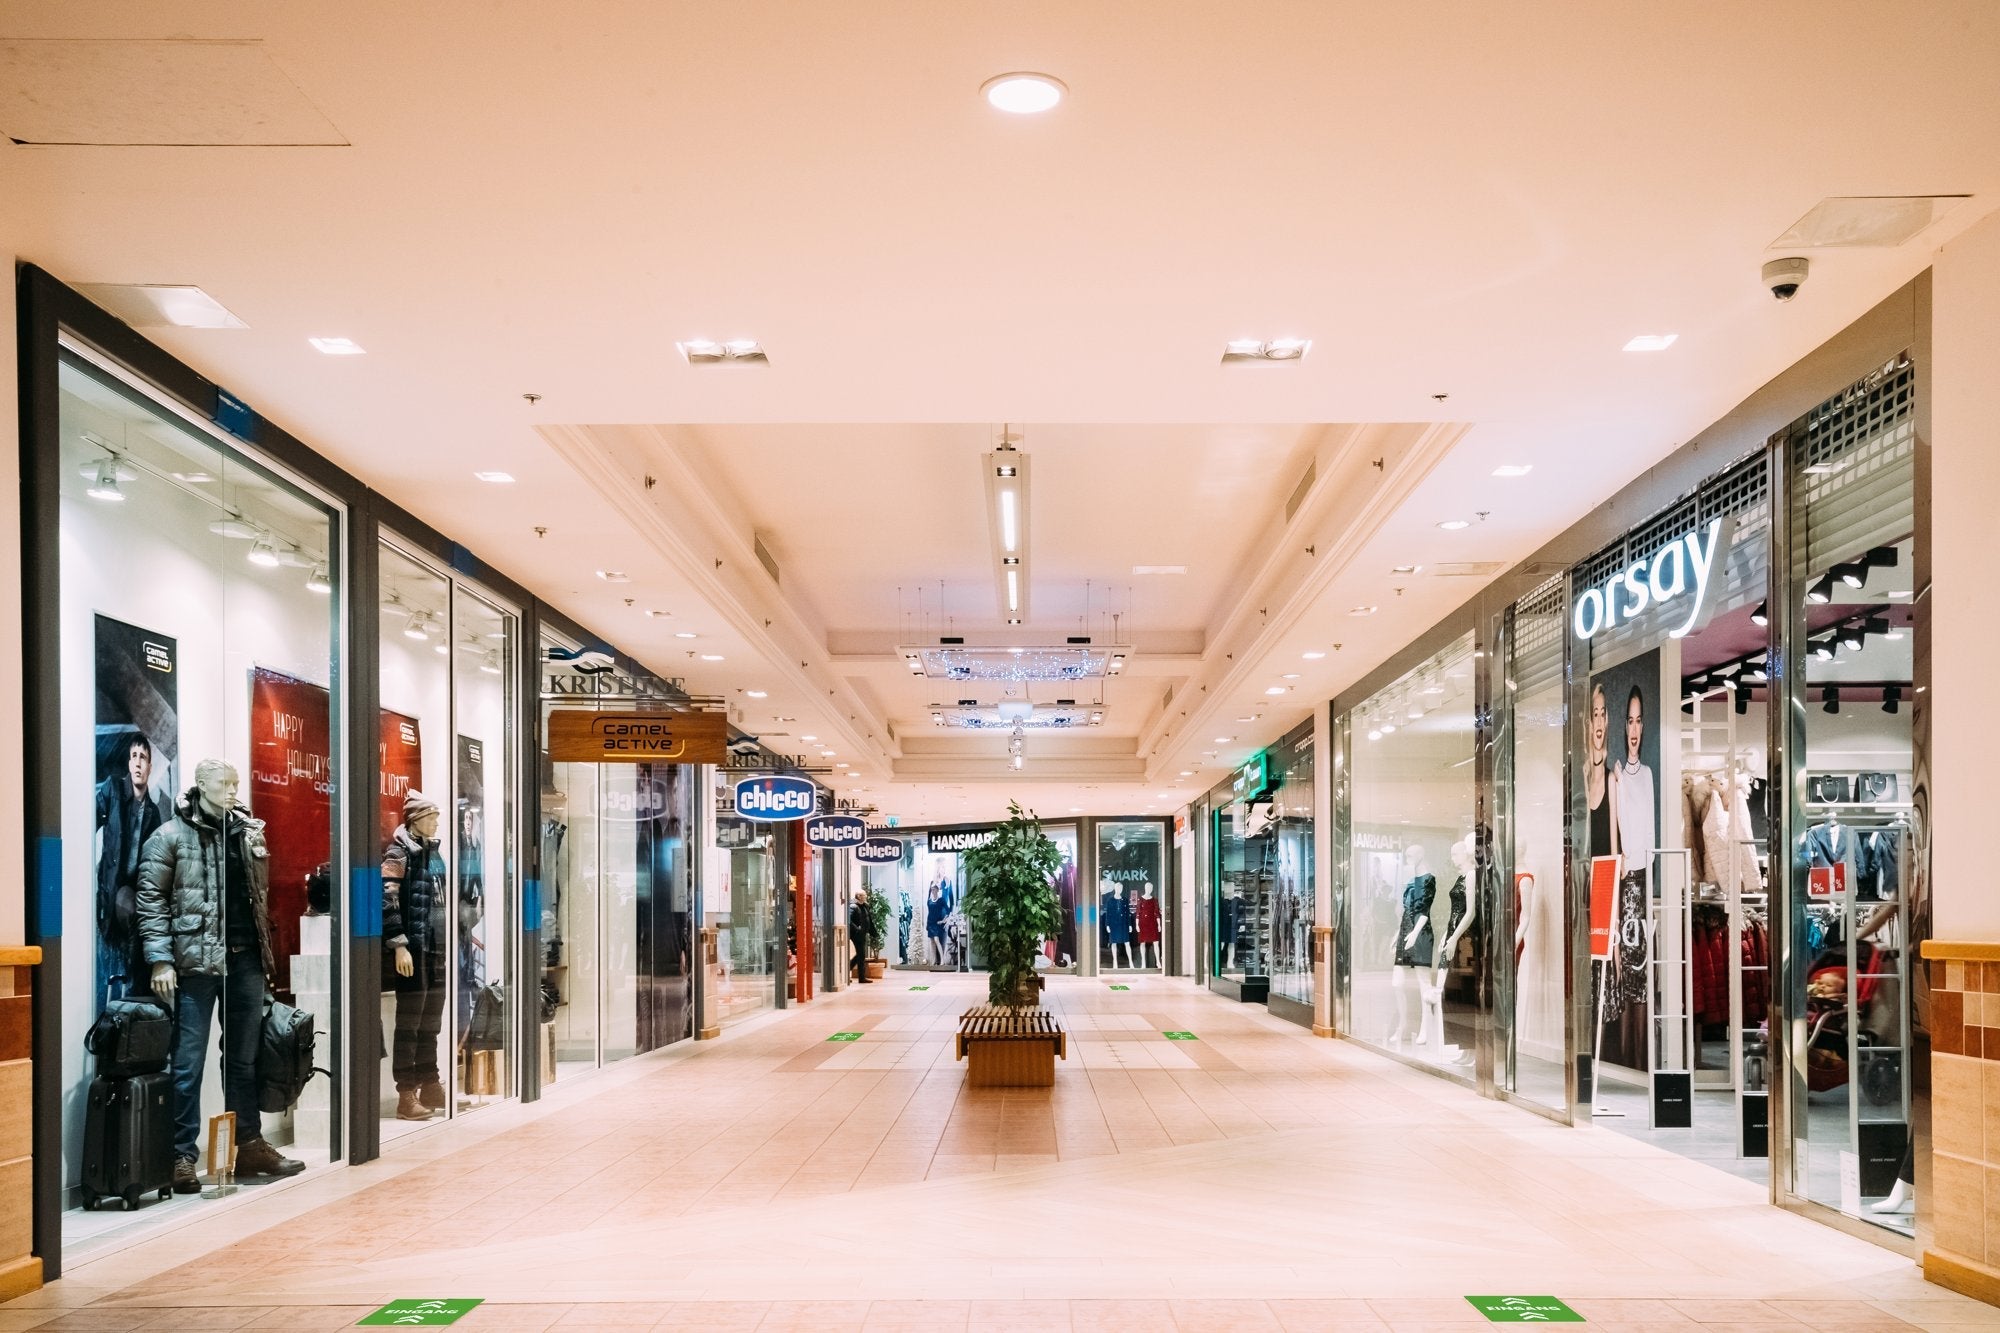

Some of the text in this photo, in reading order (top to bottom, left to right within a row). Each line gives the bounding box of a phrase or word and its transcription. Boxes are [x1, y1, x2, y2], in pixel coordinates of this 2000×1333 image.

[1575, 517, 1722, 639] orsay
[146, 646, 169, 660] camel
[146, 655, 169, 668] active
[550, 675, 686, 695] KRISTIINE
[273, 711, 304, 744] HAPPY
[603, 724, 673, 735] camel
[603, 739, 673, 750] active
[287, 749, 332, 783] HOLIDAYS
[741, 780, 811, 812] chicco
[810, 821, 863, 842] chicco
[858, 842, 900, 859] chicco
